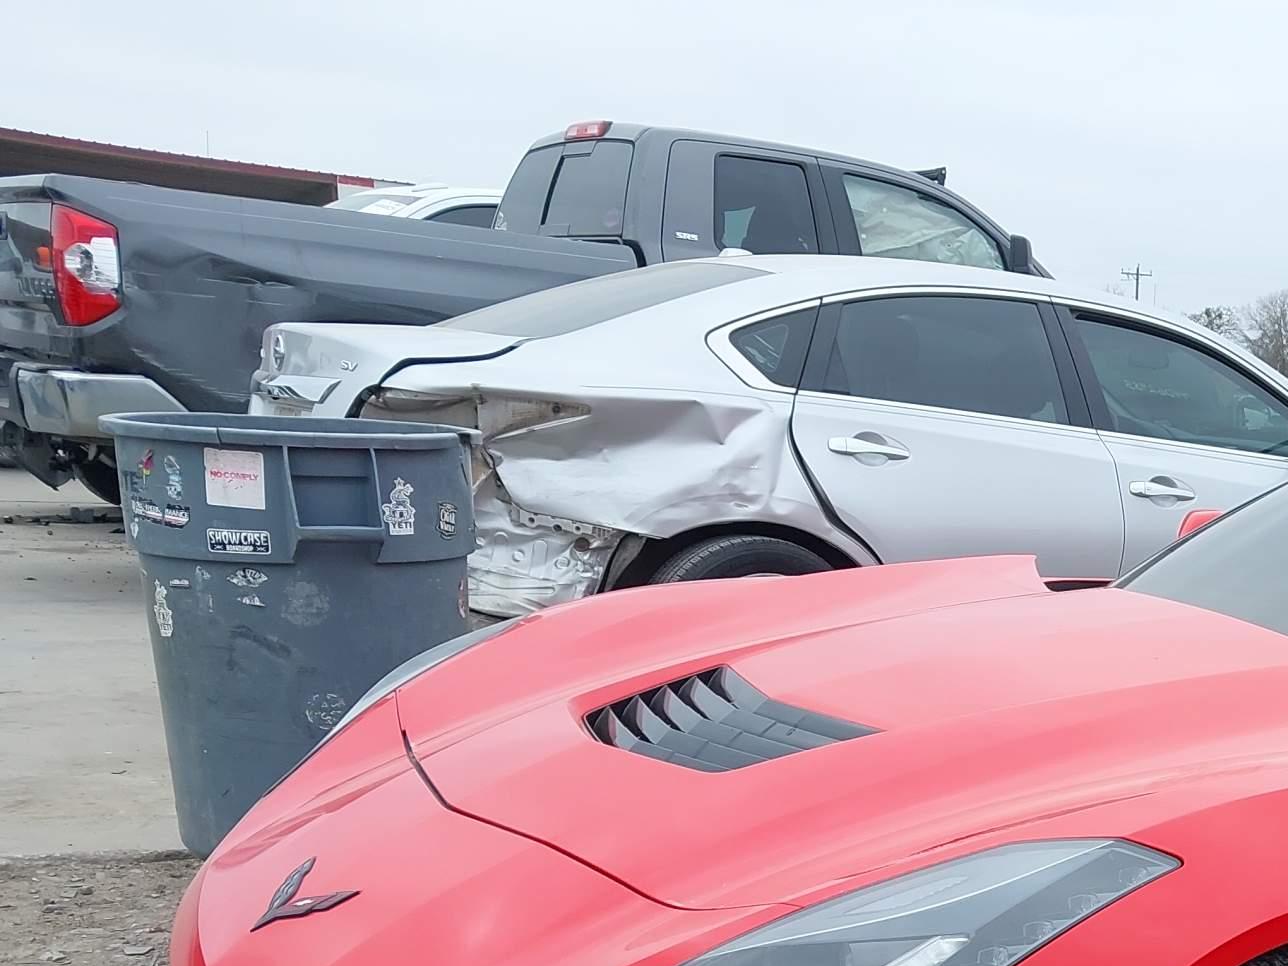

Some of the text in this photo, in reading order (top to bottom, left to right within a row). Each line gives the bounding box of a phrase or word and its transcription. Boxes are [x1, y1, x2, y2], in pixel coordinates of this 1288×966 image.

[340, 359, 359, 373] SV
[209, 470, 258, 481] NO COMPLY
[391, 521, 413, 529] YETI
[208, 530, 268, 547] SHOWCASE
